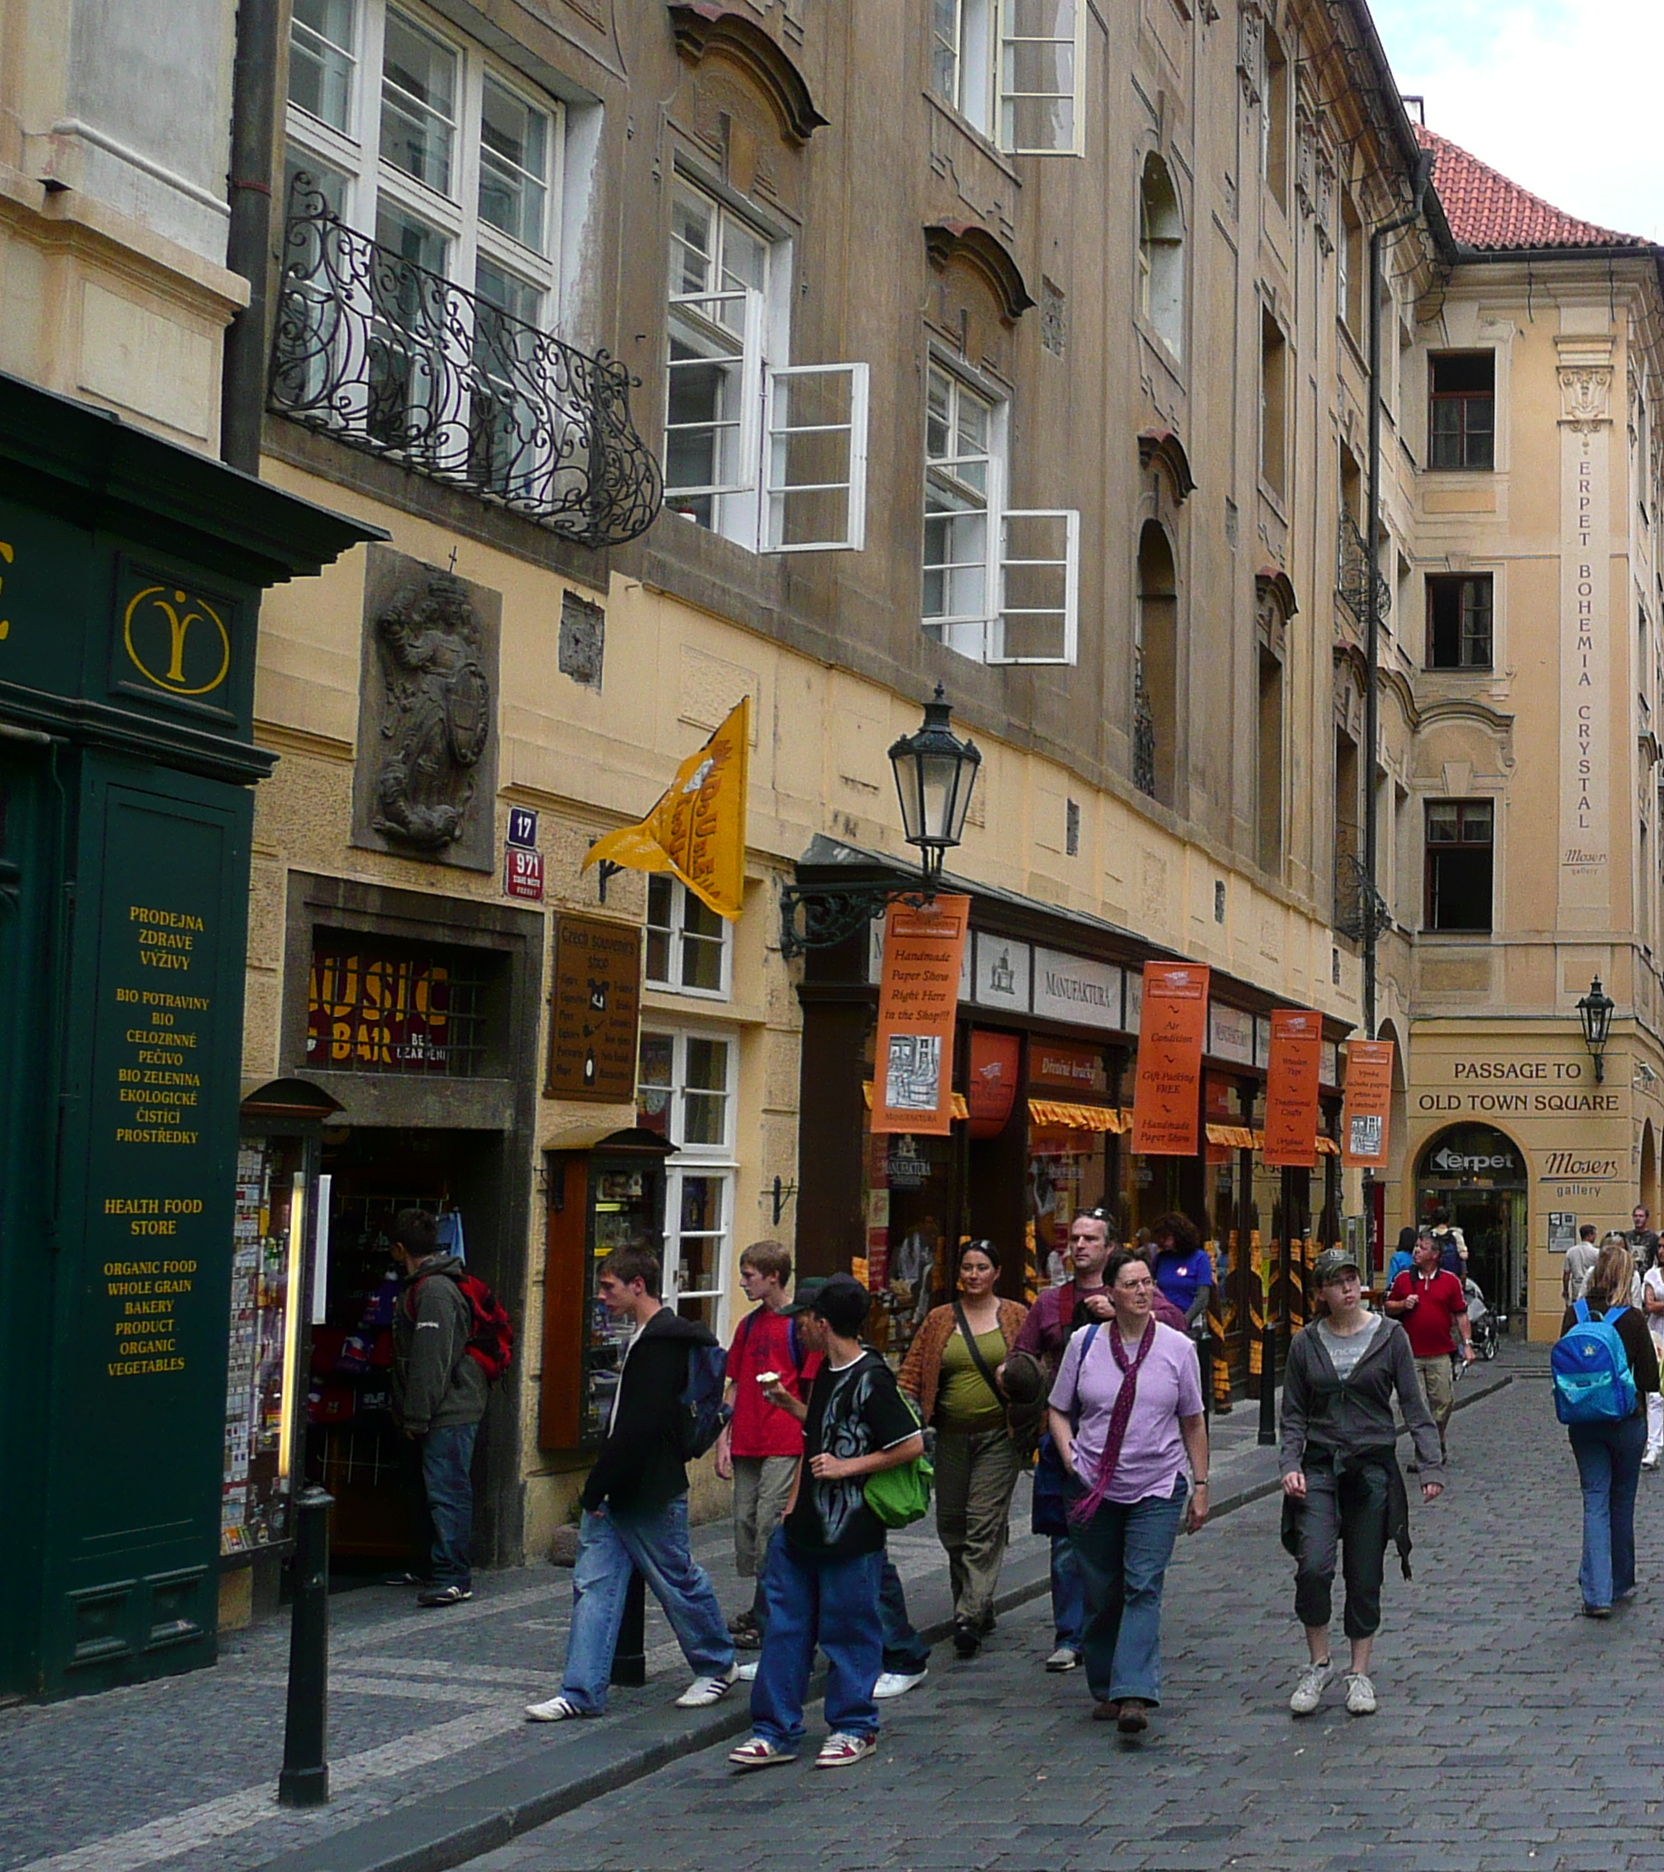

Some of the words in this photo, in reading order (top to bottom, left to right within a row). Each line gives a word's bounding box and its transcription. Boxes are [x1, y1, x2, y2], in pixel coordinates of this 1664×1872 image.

[1578, 461, 1592, 547] ERPET
[1576, 563, 1593, 687] BOHEMIA
[1577, 705, 1592, 829] CRYSTAL
[517, 815, 532, 839] 17
[1564, 846, 1608, 864] Moser
[516, 853, 539, 877] 971
[129, 905, 204, 932] PRODEJNA
[140, 948, 190, 971] VÝŽIVY
[894, 949, 952, 962] Handmade
[891, 969, 921, 984] Paper
[923, 969, 950, 982] Show
[891, 989, 919, 1004] Right
[921, 989, 946, 1001] Here
[1046, 971, 1110, 1008] MANUFAKTURA
[116, 988, 139, 1003] BIO
[142, 991, 209, 1011] POTRAVINY
[152, 1012, 174, 1026] BIO
[899, 1009, 914, 1020] the
[126, 1029, 197, 1048] CELOZRNNÉ
[331, 1022, 392, 1063] BAR
[1151, 1032, 1193, 1043] Condition
[139, 1048, 183, 1066] PEČIVO
[119, 1068, 141, 1082] BIO
[143, 1070, 201, 1087] ZELENINA
[1454, 1063, 1548, 1079] PASSAGE
[1553, 1063, 1582, 1079] TO
[120, 1088, 198, 1106] EKOLOGICKÉ
[1156, 1084, 1180, 1093] FREE
[1419, 1095, 1461, 1110] OLD
[1467, 1095, 1528, 1110] TOWN
[1534, 1095, 1619, 1111] SQUARE
[116, 1127, 199, 1144] PROSTŘEDKY
[1544, 1152, 1618, 1178] Moser
[1557, 1184, 1601, 1197] gallery
[104, 1199, 159, 1214] HEALTH
[163, 1199, 203, 1214] FOOD
[130, 1220, 177, 1235] STORE
[103, 1261, 160, 1276] ORGANIC
[162, 1260, 198, 1274] FOOD
[107, 1281, 152, 1296] WHOLE
[154, 1279, 192, 1294] GRAIN
[124, 1299, 175, 1315] BAKERY
[114, 1319, 175, 1336] PRODUCT
[120, 1338, 176, 1355] ORGANIC
[107, 1357, 186, 1377] VEGETABLES
